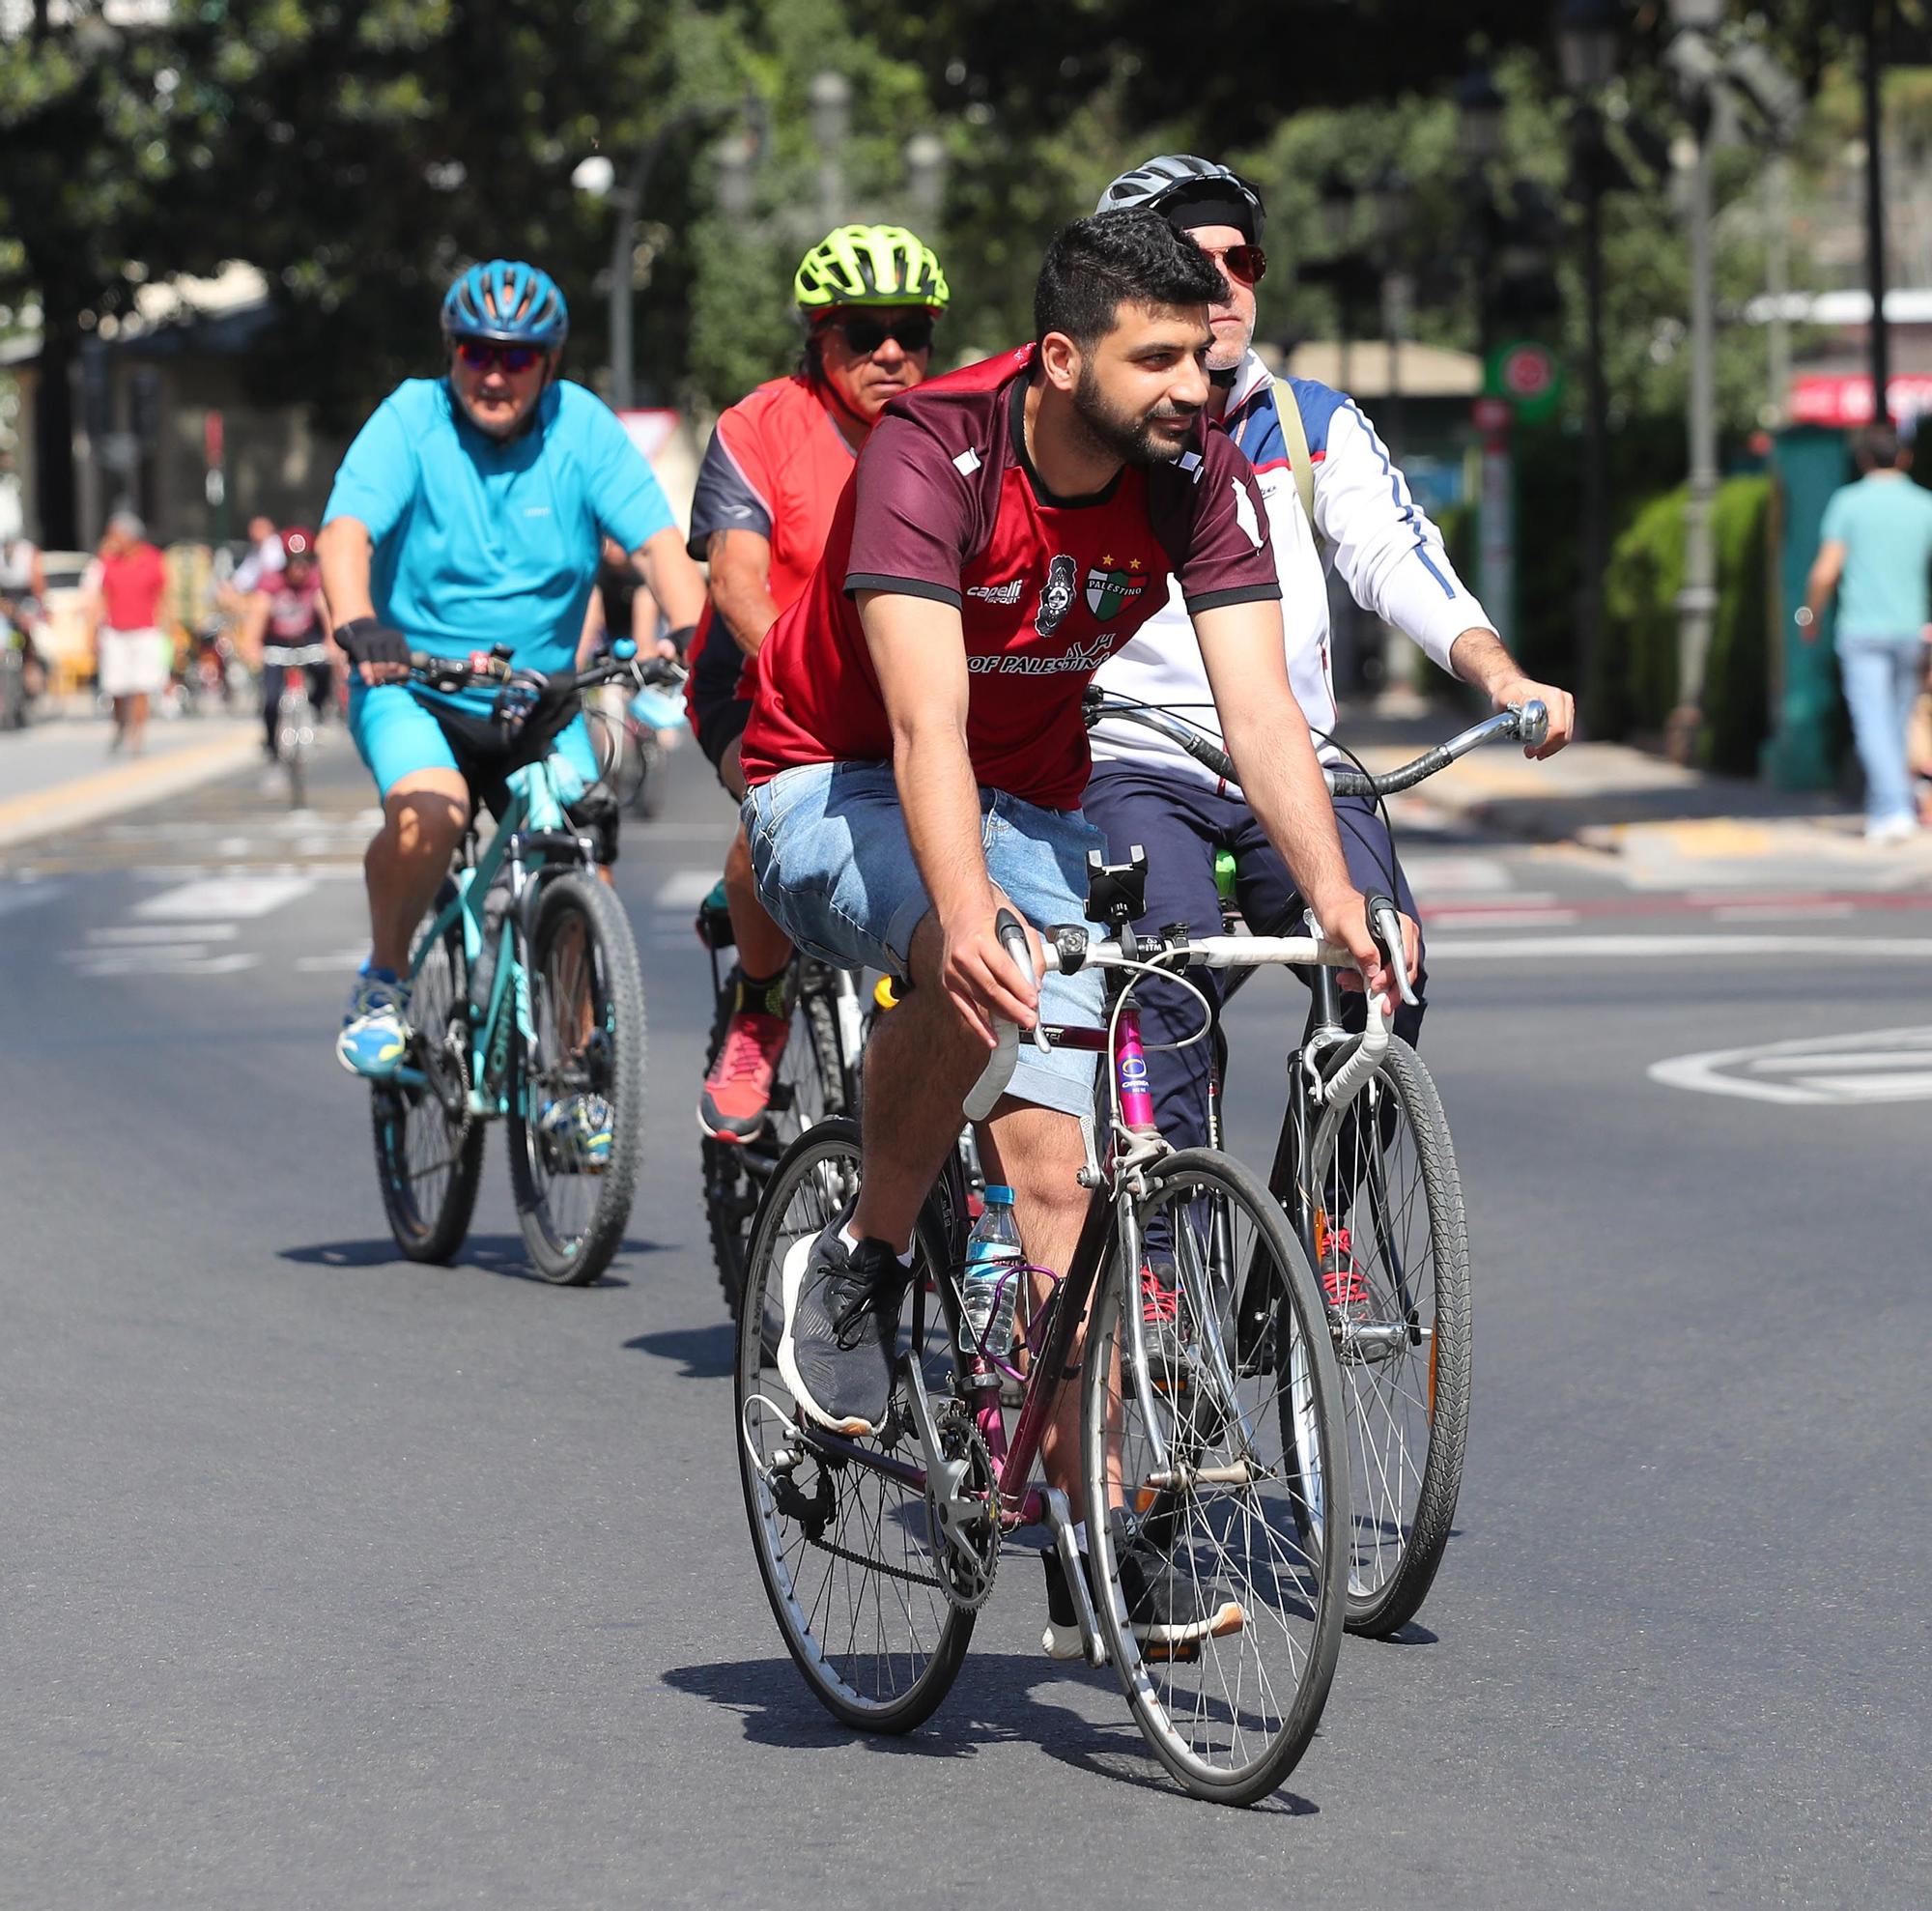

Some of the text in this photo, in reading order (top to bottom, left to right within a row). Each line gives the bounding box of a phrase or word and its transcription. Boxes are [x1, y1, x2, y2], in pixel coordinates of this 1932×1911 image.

[966, 579, 1023, 602] capelli
[1088, 580, 1142, 596] PALESTINO
[966, 656, 999, 673] OF
